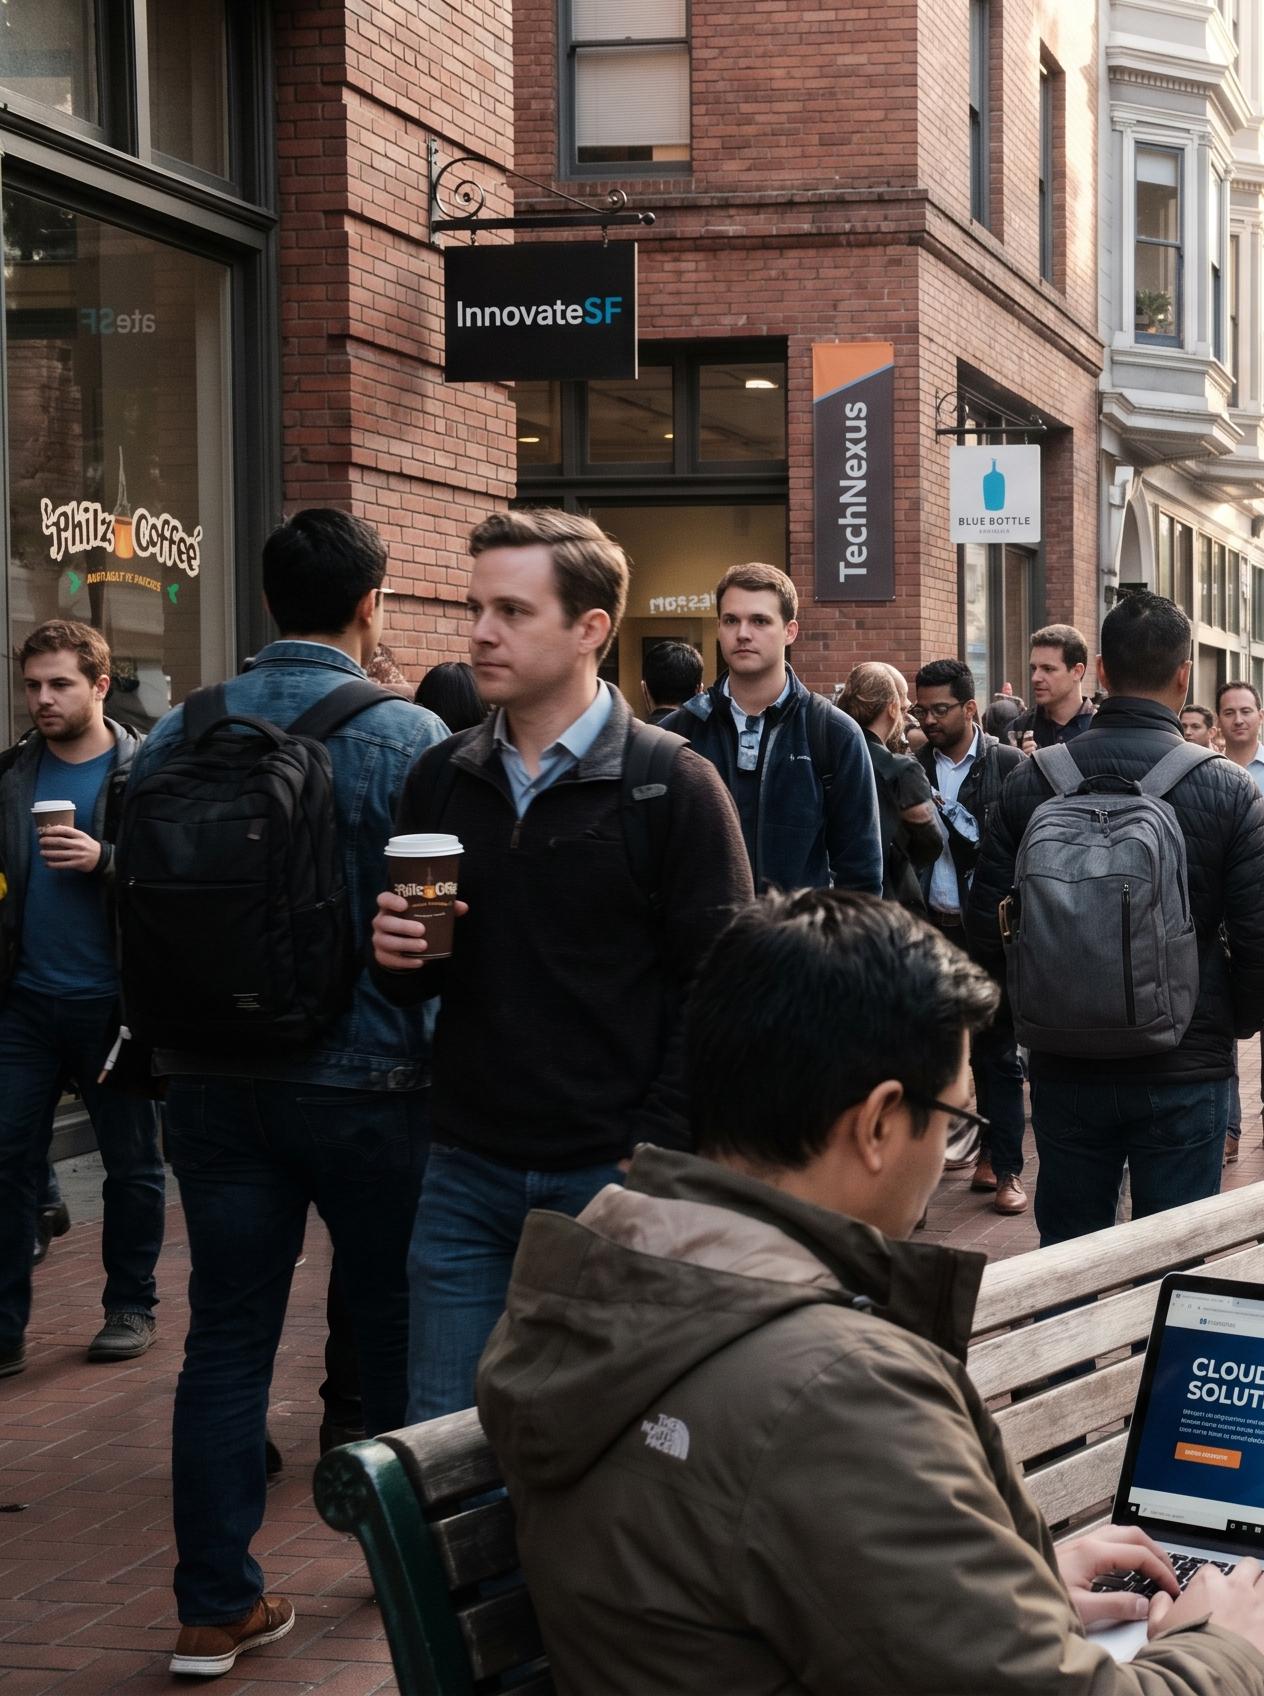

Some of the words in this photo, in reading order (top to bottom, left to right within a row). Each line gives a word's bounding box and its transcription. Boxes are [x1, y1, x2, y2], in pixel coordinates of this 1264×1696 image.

[457, 297, 622, 327] InnovateSF
[838, 402, 867, 582] TechNexus
[39, 498, 115, 561] Philz
[132, 508, 203, 577] Coffee
[958, 517, 986, 526] BLUE
[989, 516, 1031, 525] BOTTLE
